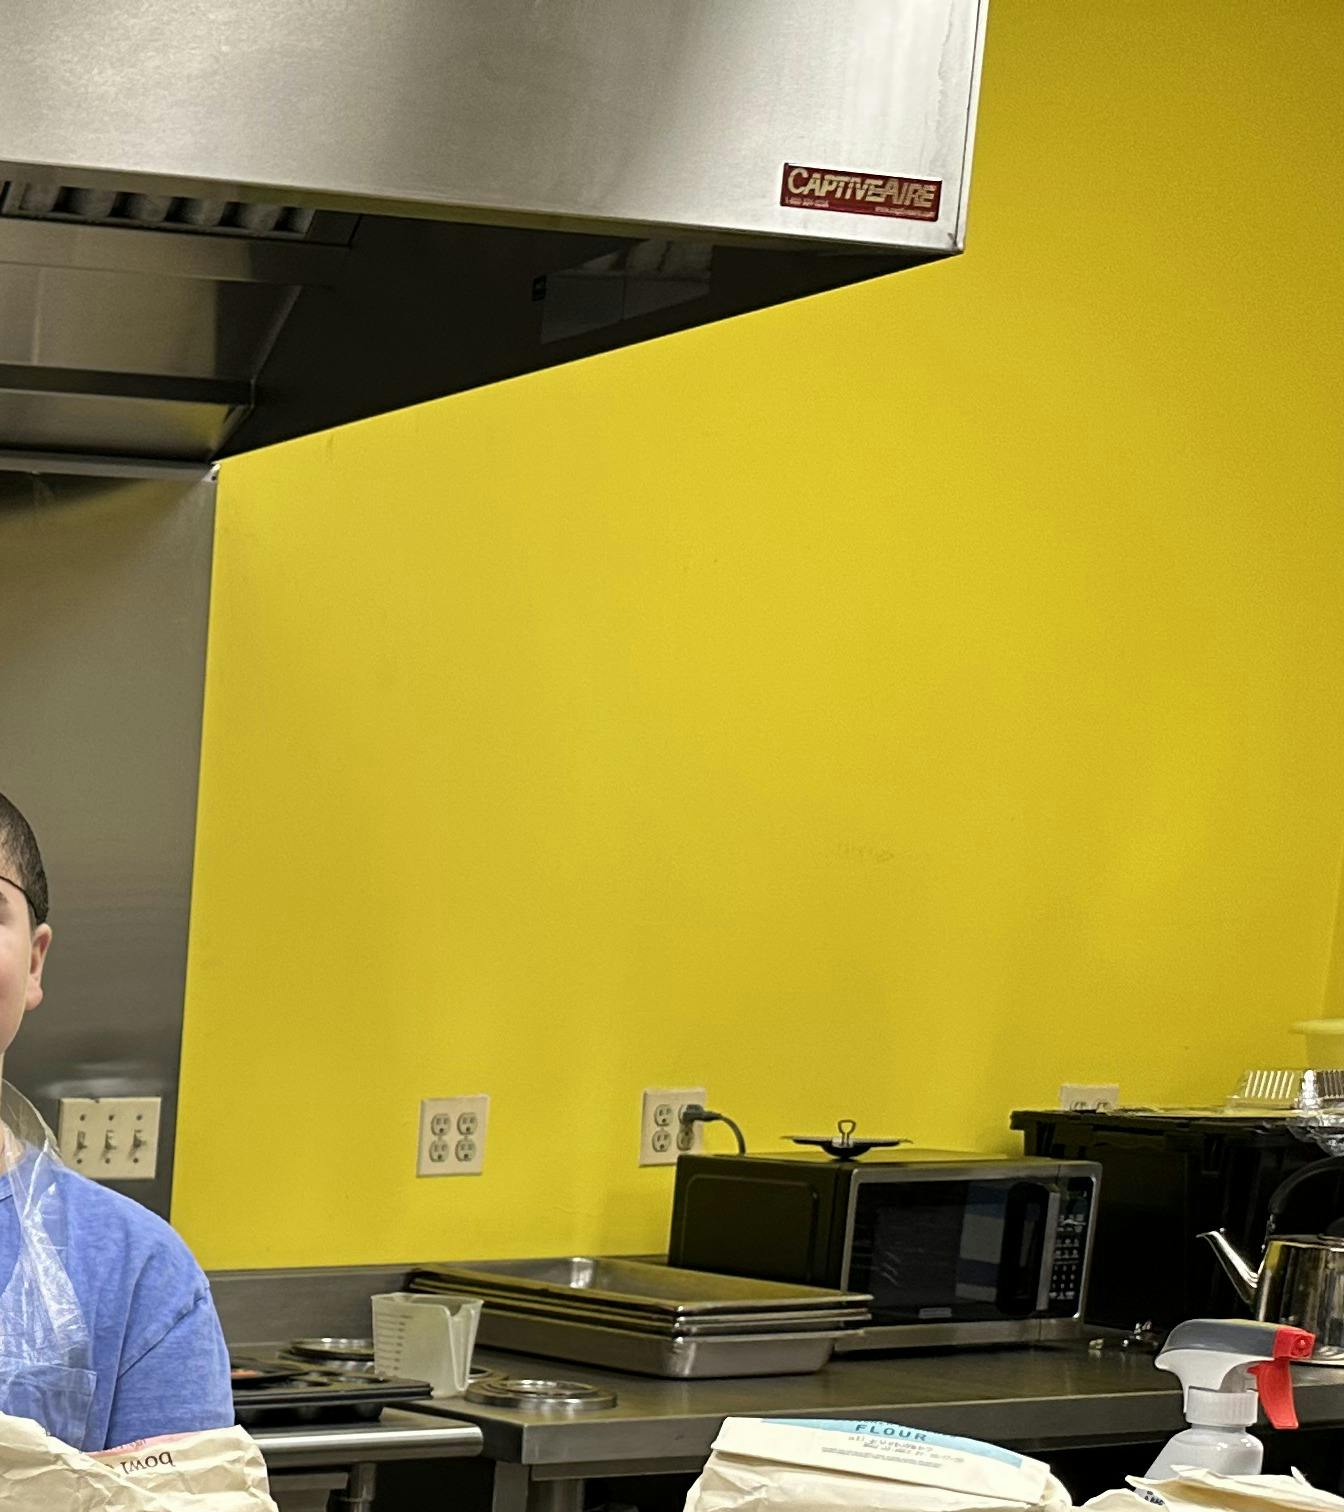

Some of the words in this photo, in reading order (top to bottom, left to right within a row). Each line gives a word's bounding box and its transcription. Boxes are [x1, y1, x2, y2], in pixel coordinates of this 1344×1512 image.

[787, 167, 936, 208] CAPTIVEAIRE
[855, 1424, 928, 1441] FLOUR
[120, 1451, 176, 1474] bowl
